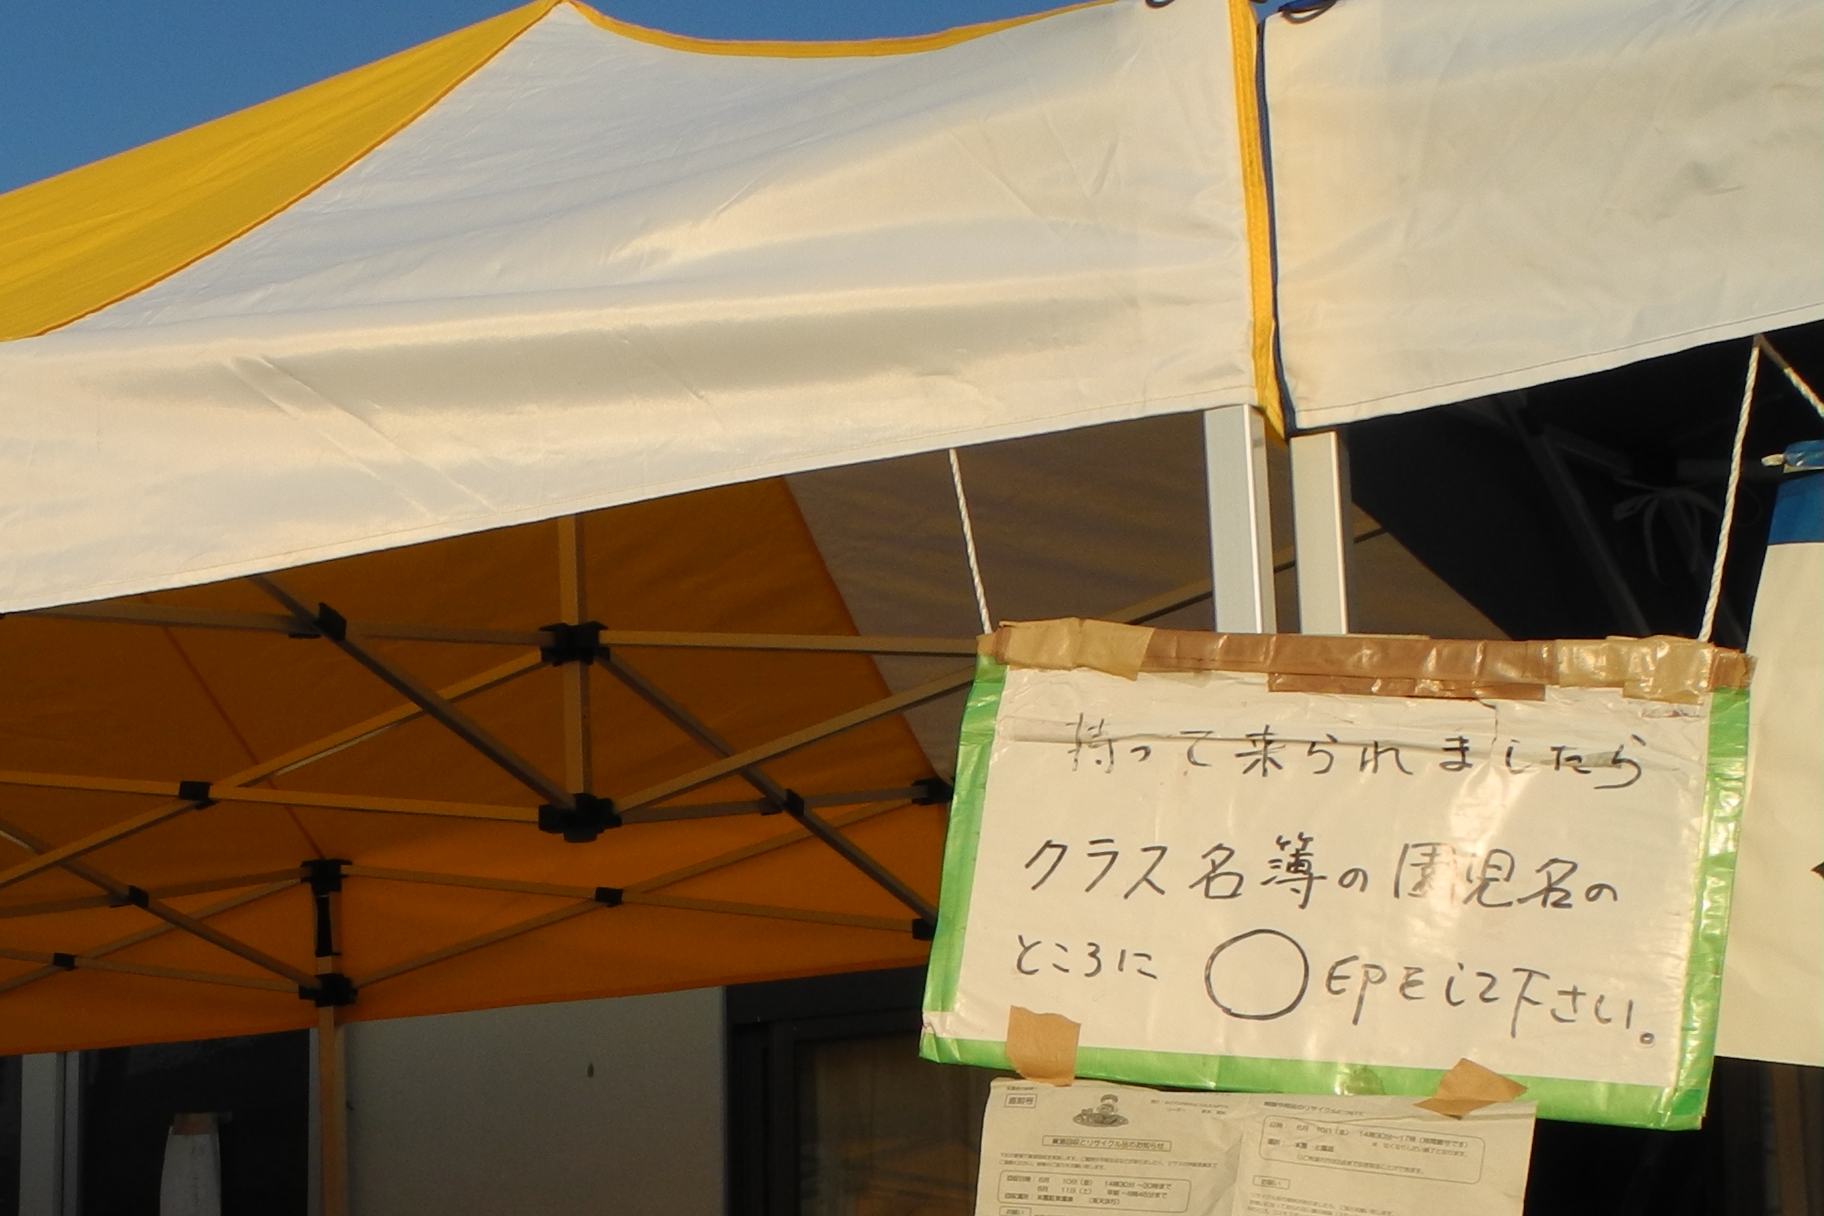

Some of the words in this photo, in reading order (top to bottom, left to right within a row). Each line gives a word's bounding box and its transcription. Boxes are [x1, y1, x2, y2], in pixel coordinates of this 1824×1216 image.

[1066, 712, 1645, 790] 持って来られましたら
[1024, 832, 1619, 910] クラス名簿の園児名の
